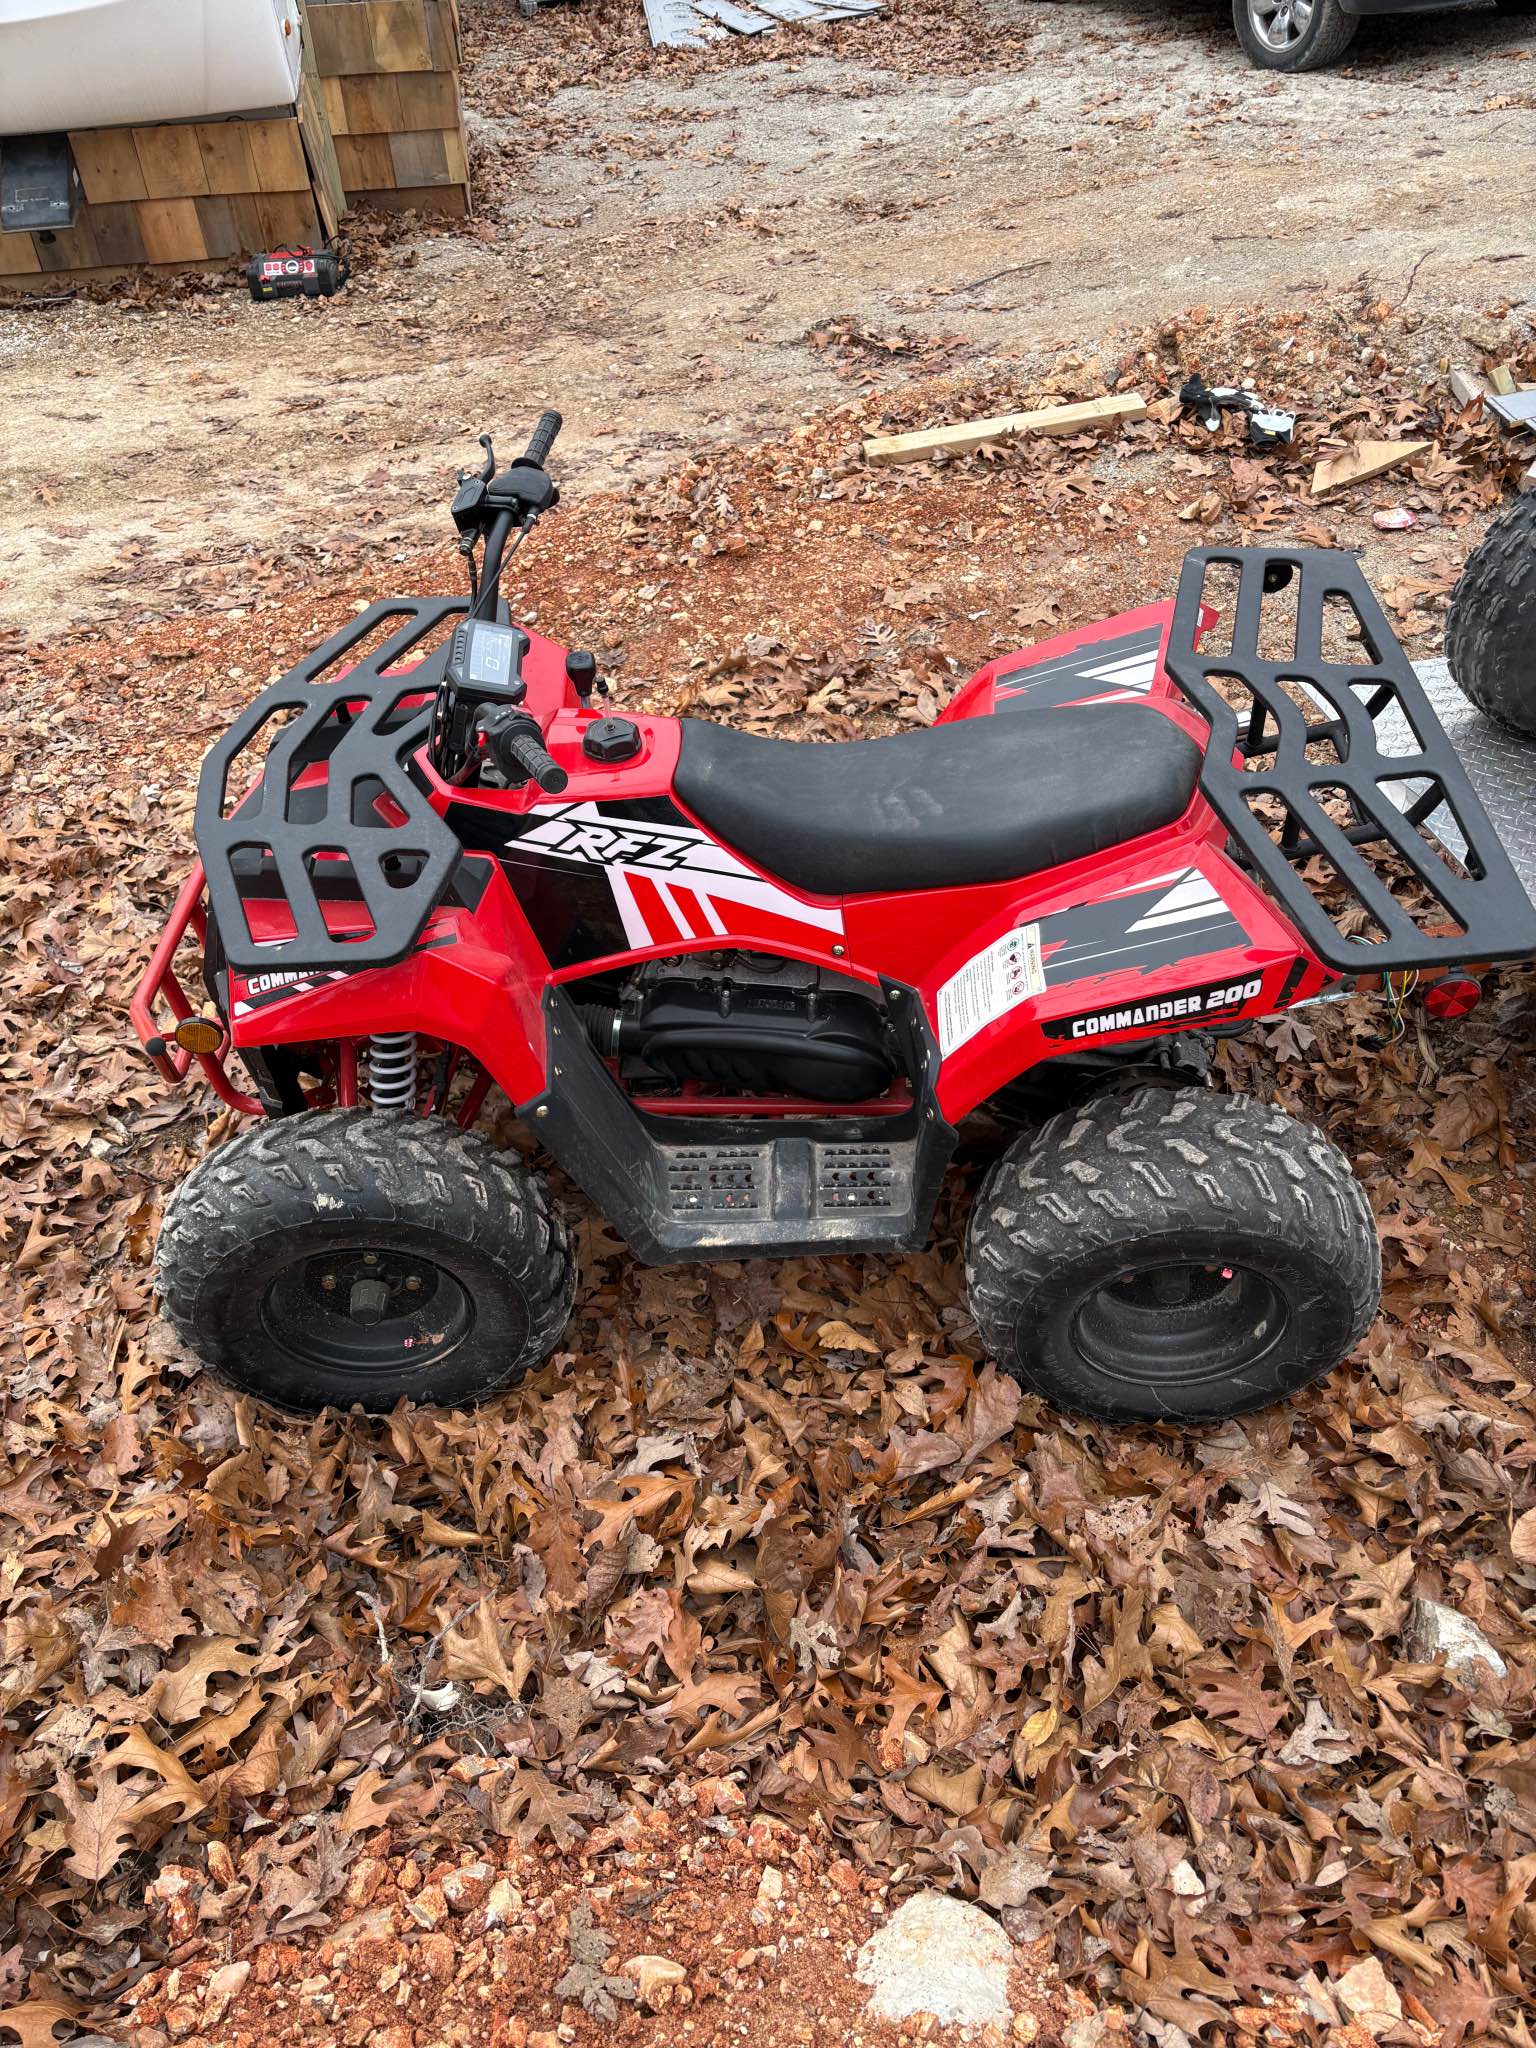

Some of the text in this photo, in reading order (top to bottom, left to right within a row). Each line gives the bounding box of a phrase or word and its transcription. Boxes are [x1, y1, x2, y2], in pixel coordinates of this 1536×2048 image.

[554, 822, 700, 871] RFZ
[1071, 979, 1263, 1038] COMMANDER 200
